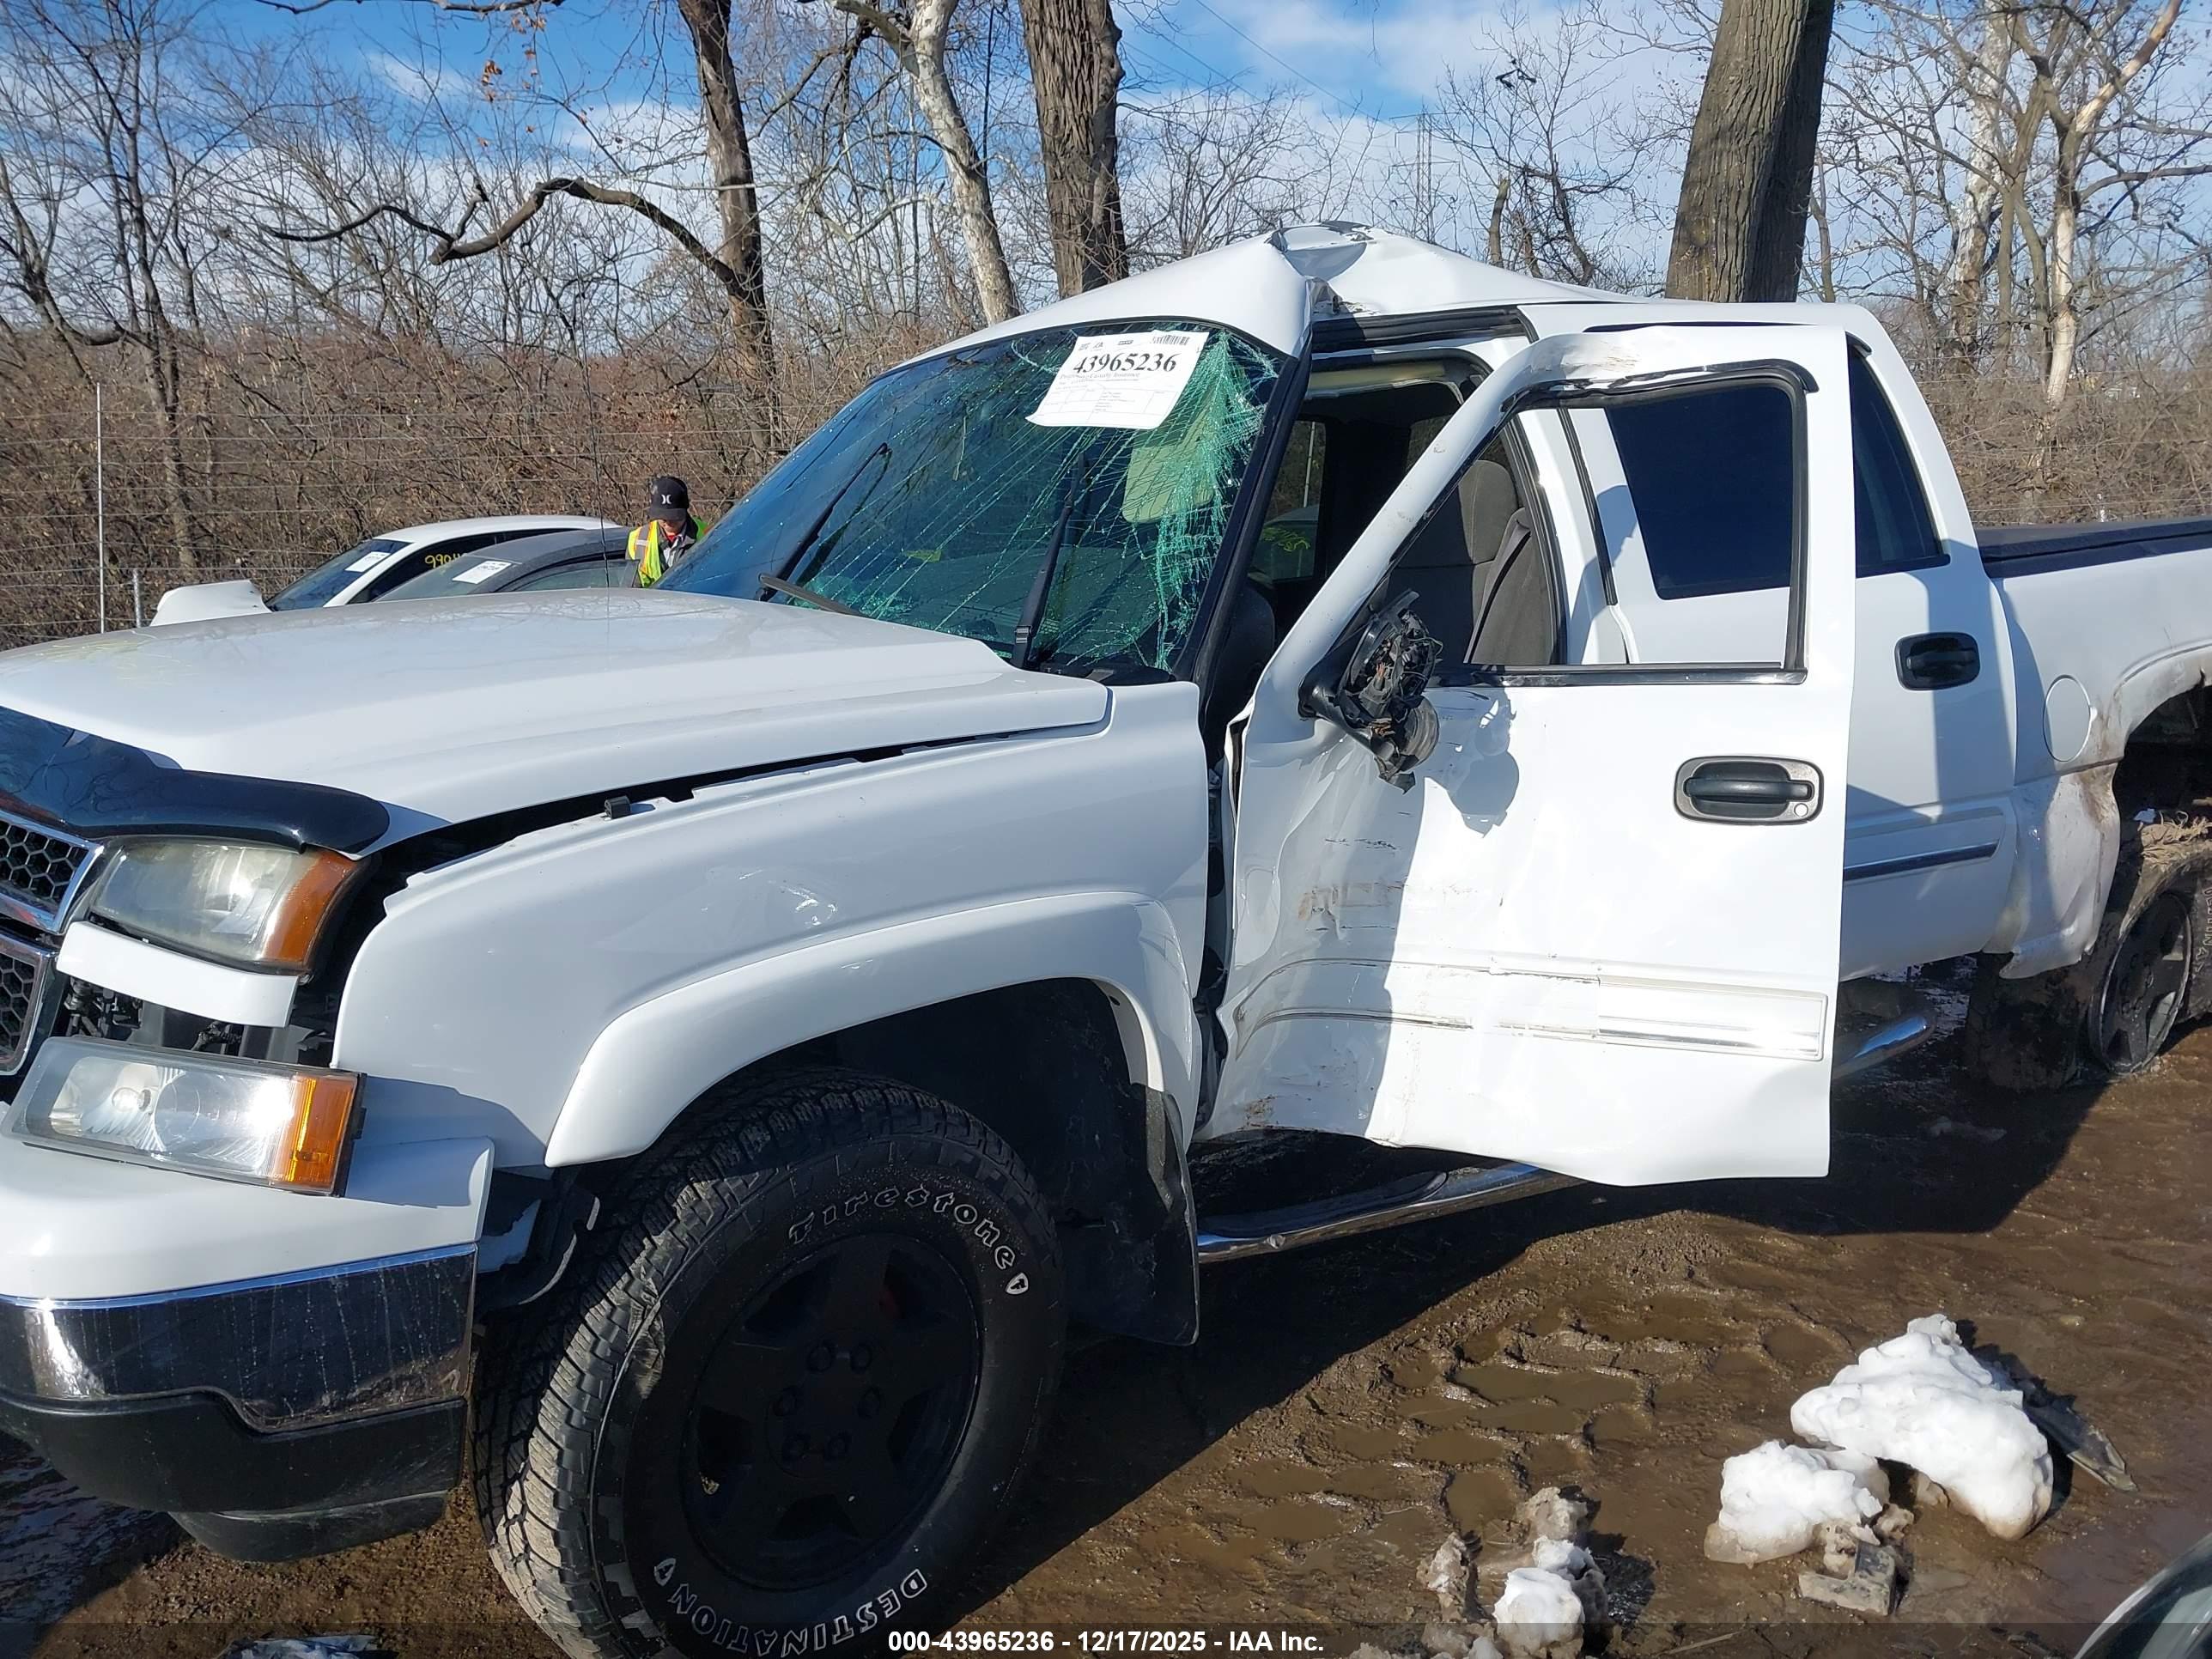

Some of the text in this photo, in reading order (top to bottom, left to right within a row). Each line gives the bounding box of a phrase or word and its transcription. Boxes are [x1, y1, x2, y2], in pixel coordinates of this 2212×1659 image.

[1073, 352, 1182, 374] 43965236
[788, 1185, 1016, 1270] Firestone
[667, 1568, 929, 1658] DESTINATION
